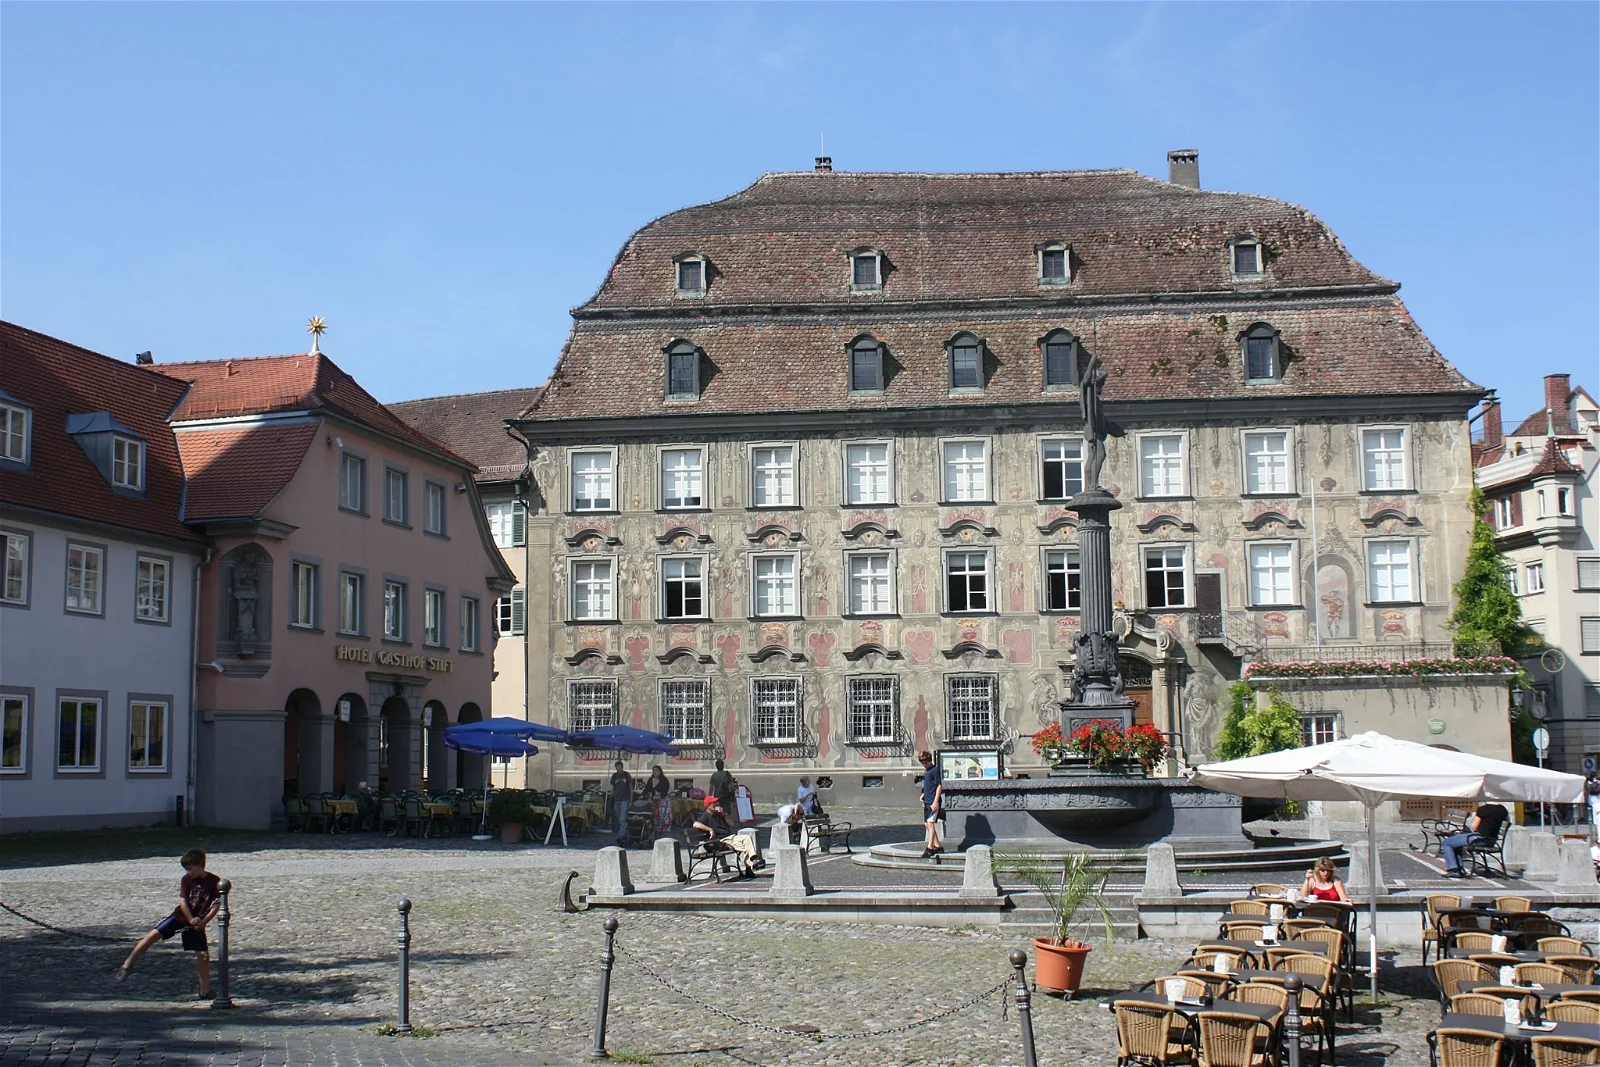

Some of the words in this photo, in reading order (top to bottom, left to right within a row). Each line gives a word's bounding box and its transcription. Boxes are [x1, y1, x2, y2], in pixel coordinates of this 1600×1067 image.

[338, 645, 373, 663] HOTEL
[378, 650, 425, 668] GASTHOF
[428, 657, 455, 672] STIFT
